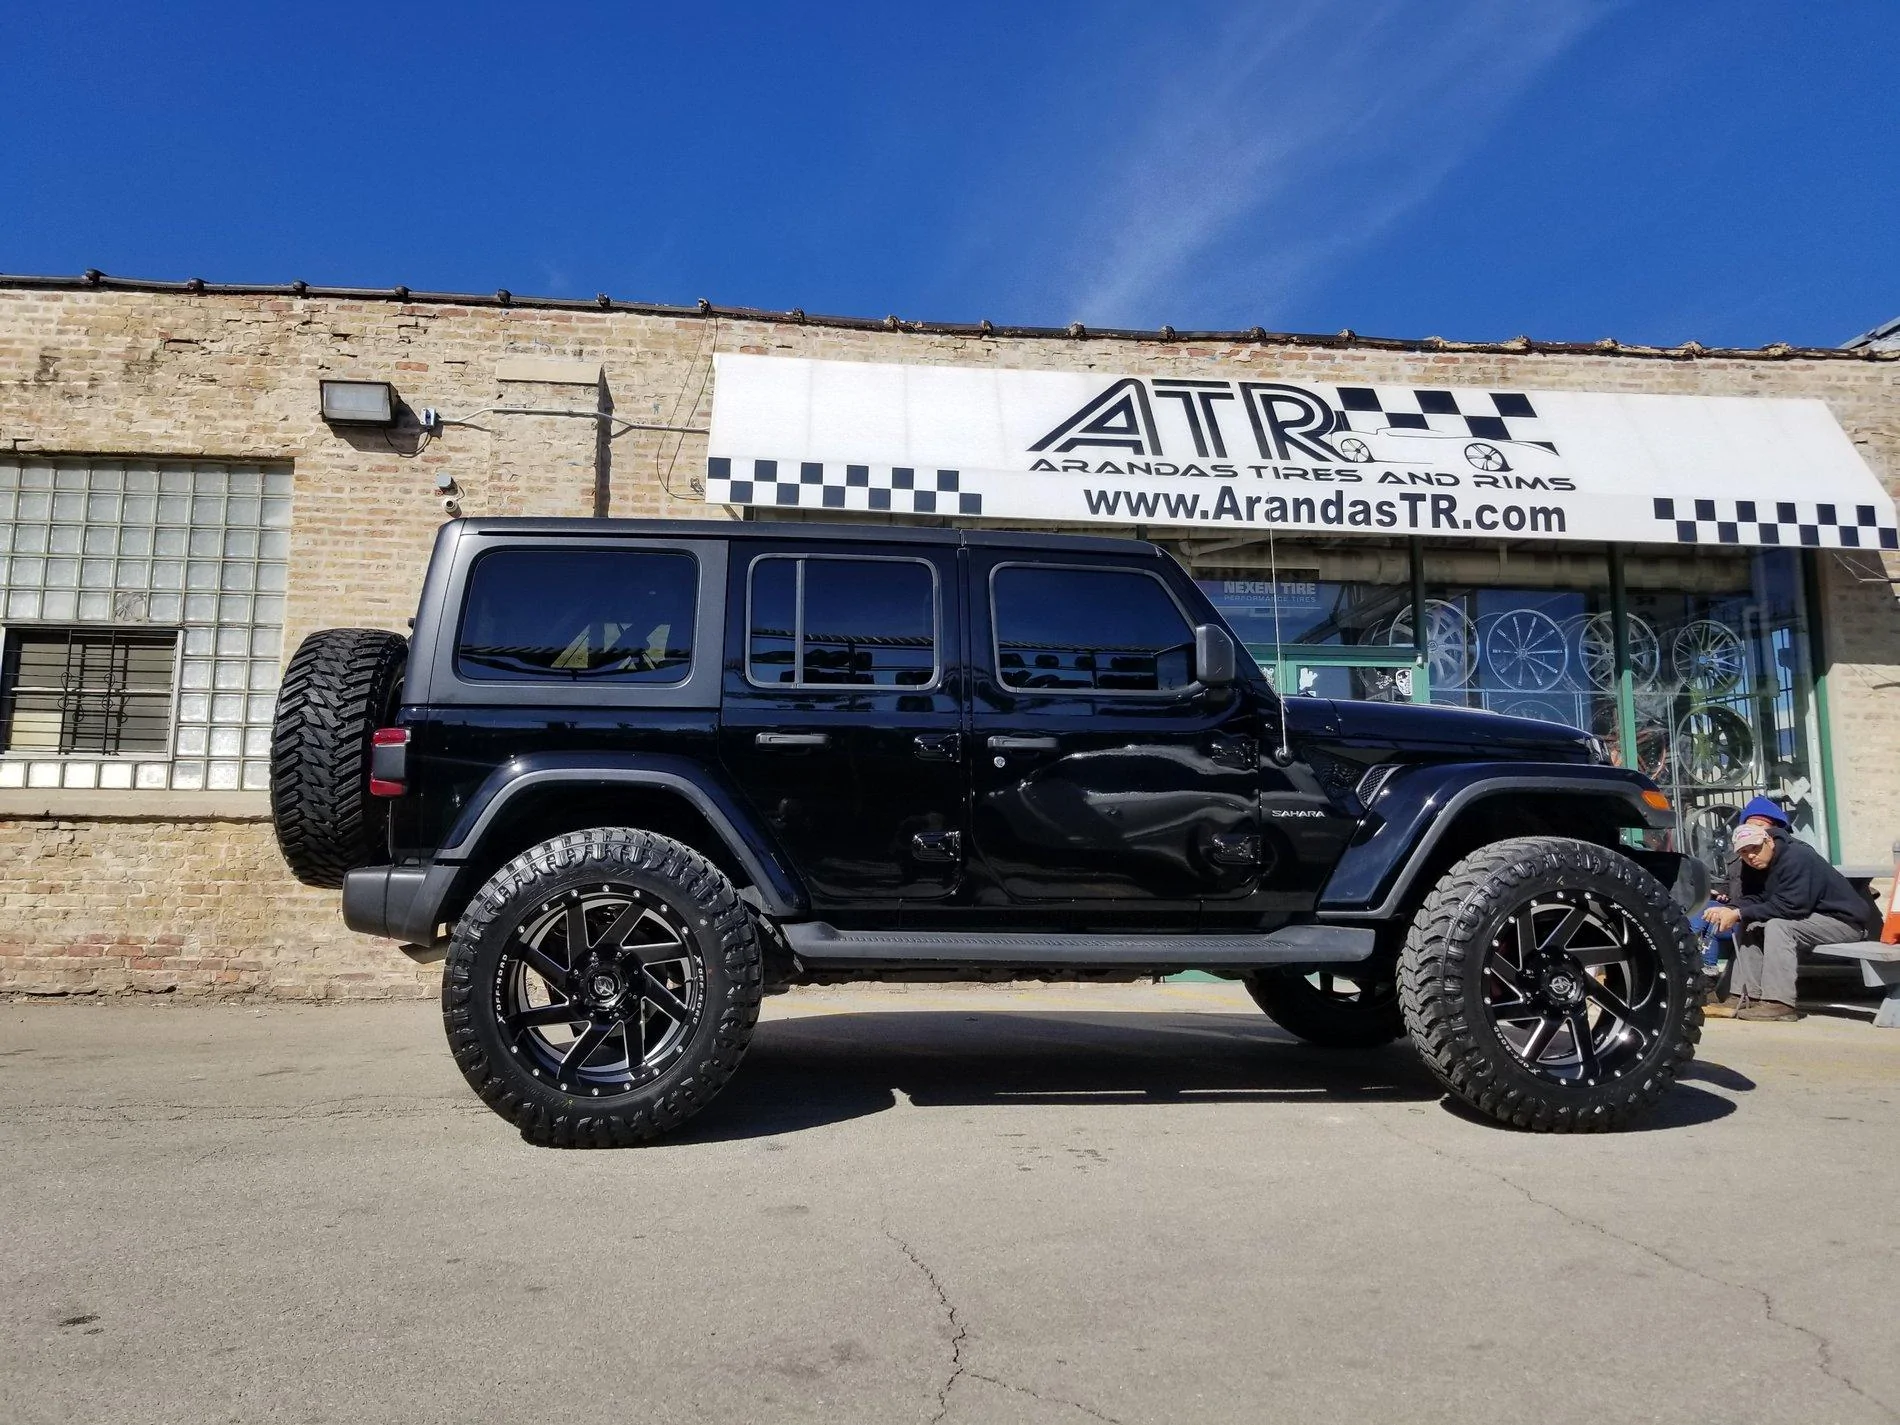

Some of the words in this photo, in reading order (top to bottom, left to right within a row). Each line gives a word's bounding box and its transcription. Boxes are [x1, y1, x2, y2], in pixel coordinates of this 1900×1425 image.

[1027, 378, 1352, 463] ATR
[1029, 458, 1238, 478] ARANDAS
[1247, 466, 1363, 483] TIRES
[1377, 471, 1461, 487] AND
[1473, 475, 1577, 492] RIMS
[1083, 486, 1566, 533] www.ArandasTR.com
[1223, 581, 1275, 594] NEXEN
[1281, 582, 1316, 595] TIRE
